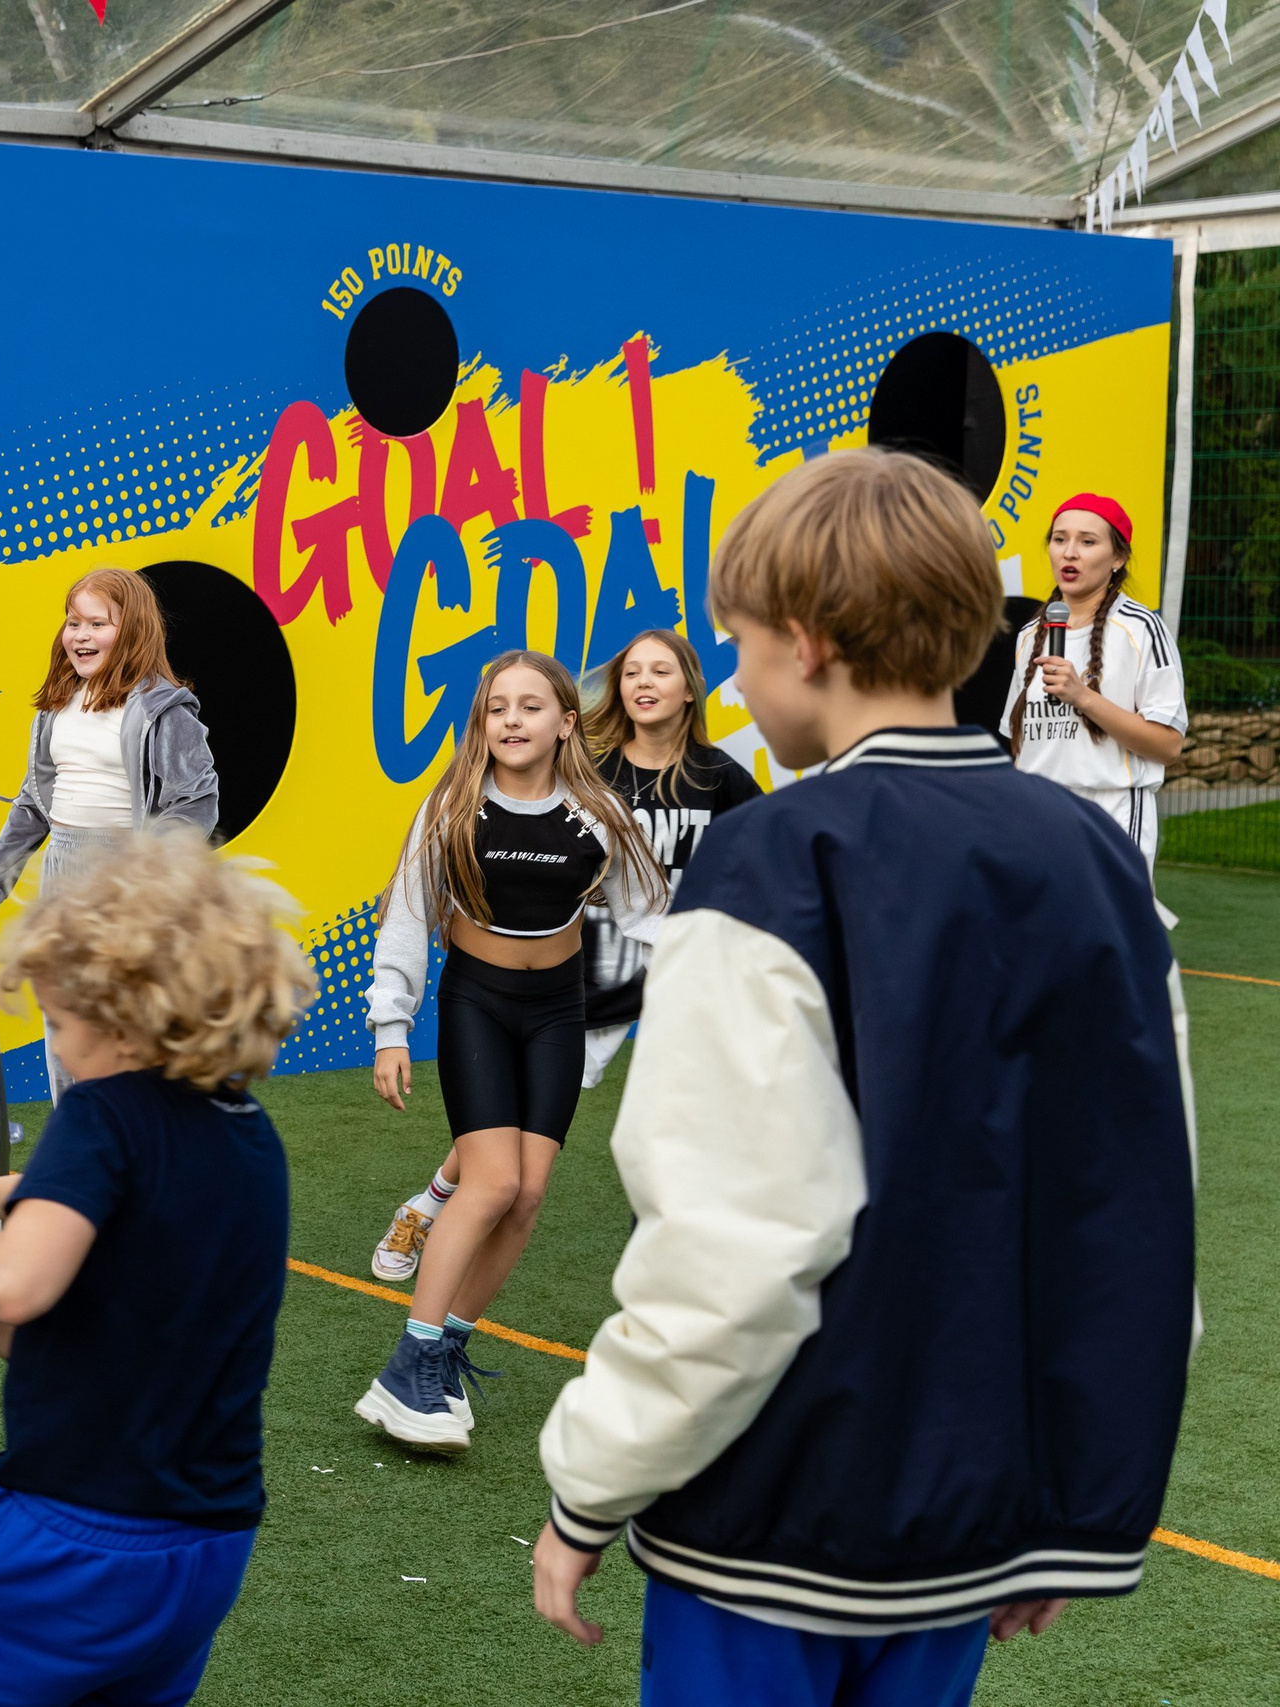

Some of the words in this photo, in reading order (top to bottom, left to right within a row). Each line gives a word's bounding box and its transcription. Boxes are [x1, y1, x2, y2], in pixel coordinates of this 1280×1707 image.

[321, 266, 364, 321] 150
[368, 243, 463, 297] POINTS
[999, 383, 1042, 523] POINTS
[373, 469, 744, 784] GOAL
[1023, 722, 1042, 741] FLY
[493, 850, 559, 864] FLAWLESS
[631, 808, 711, 866] ON'T
